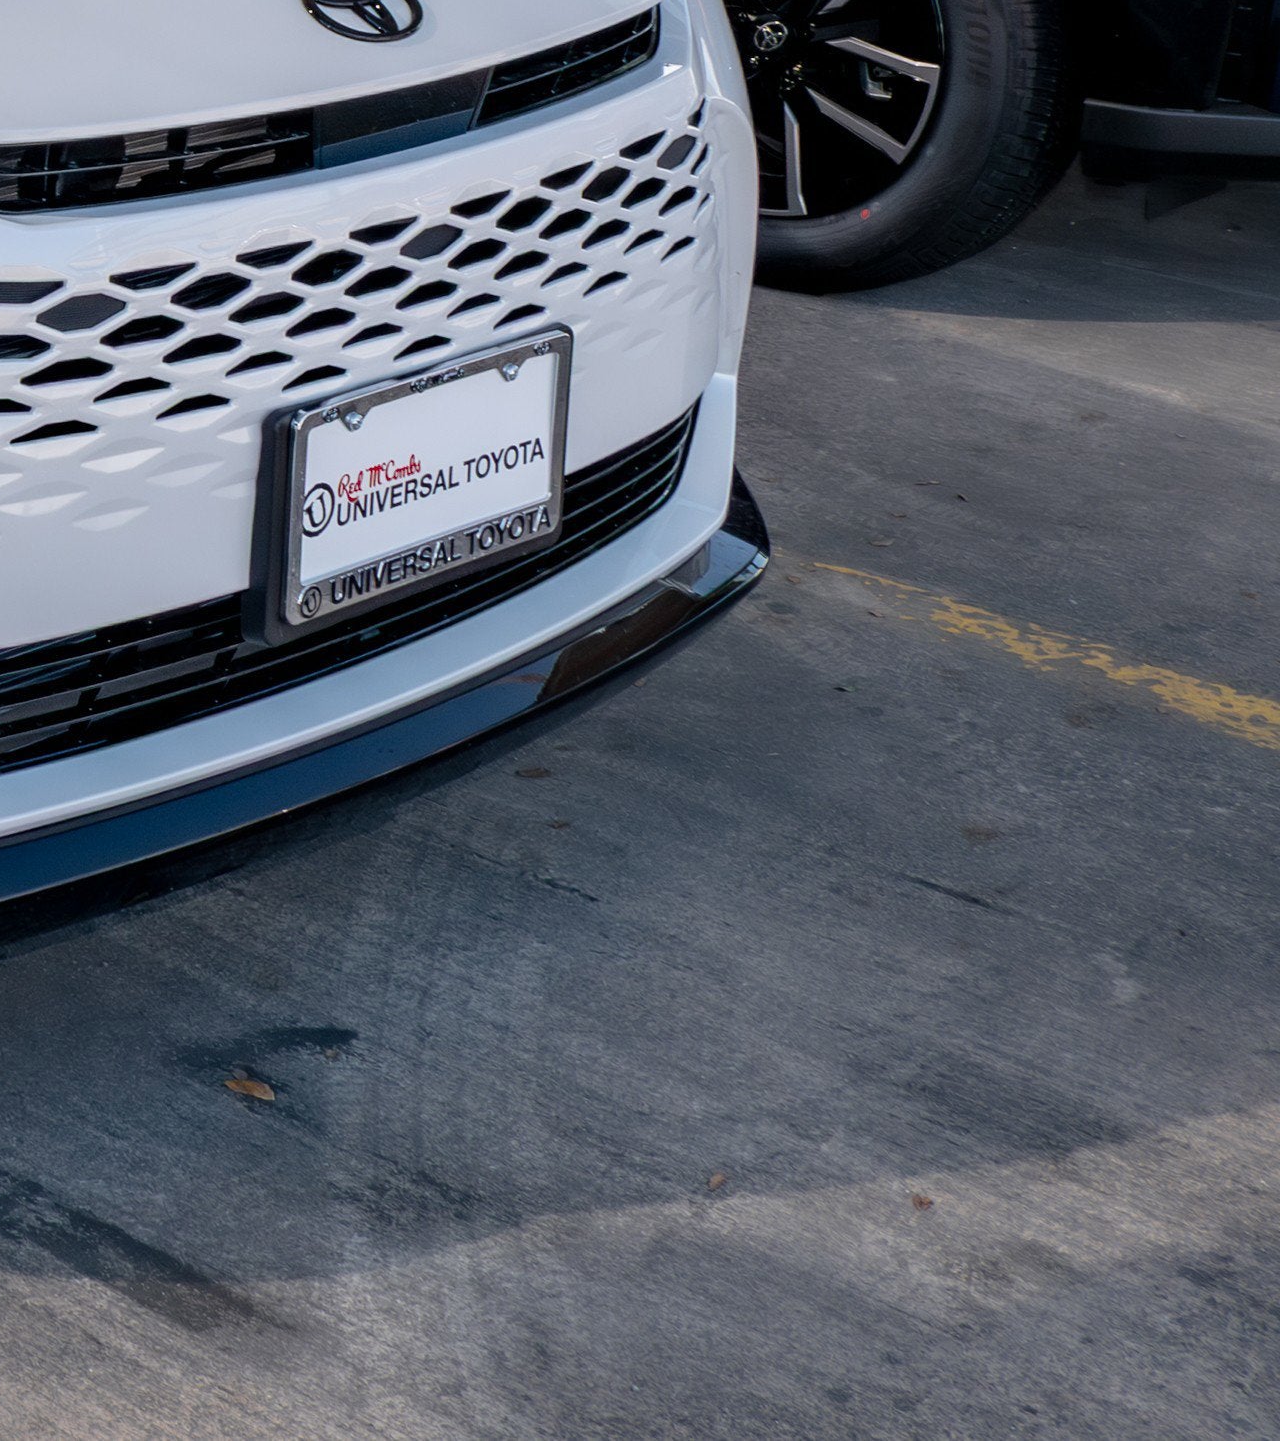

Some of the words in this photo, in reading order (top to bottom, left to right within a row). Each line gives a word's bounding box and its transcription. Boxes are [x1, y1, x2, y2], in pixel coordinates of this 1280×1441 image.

[336, 465, 459, 527] UNIVERSAL
[463, 437, 544, 483] TOYOTA
[338, 469, 364, 502] Red
[330, 536, 463, 605] UNIVERSAL
[465, 506, 551, 551] TOYOTA
